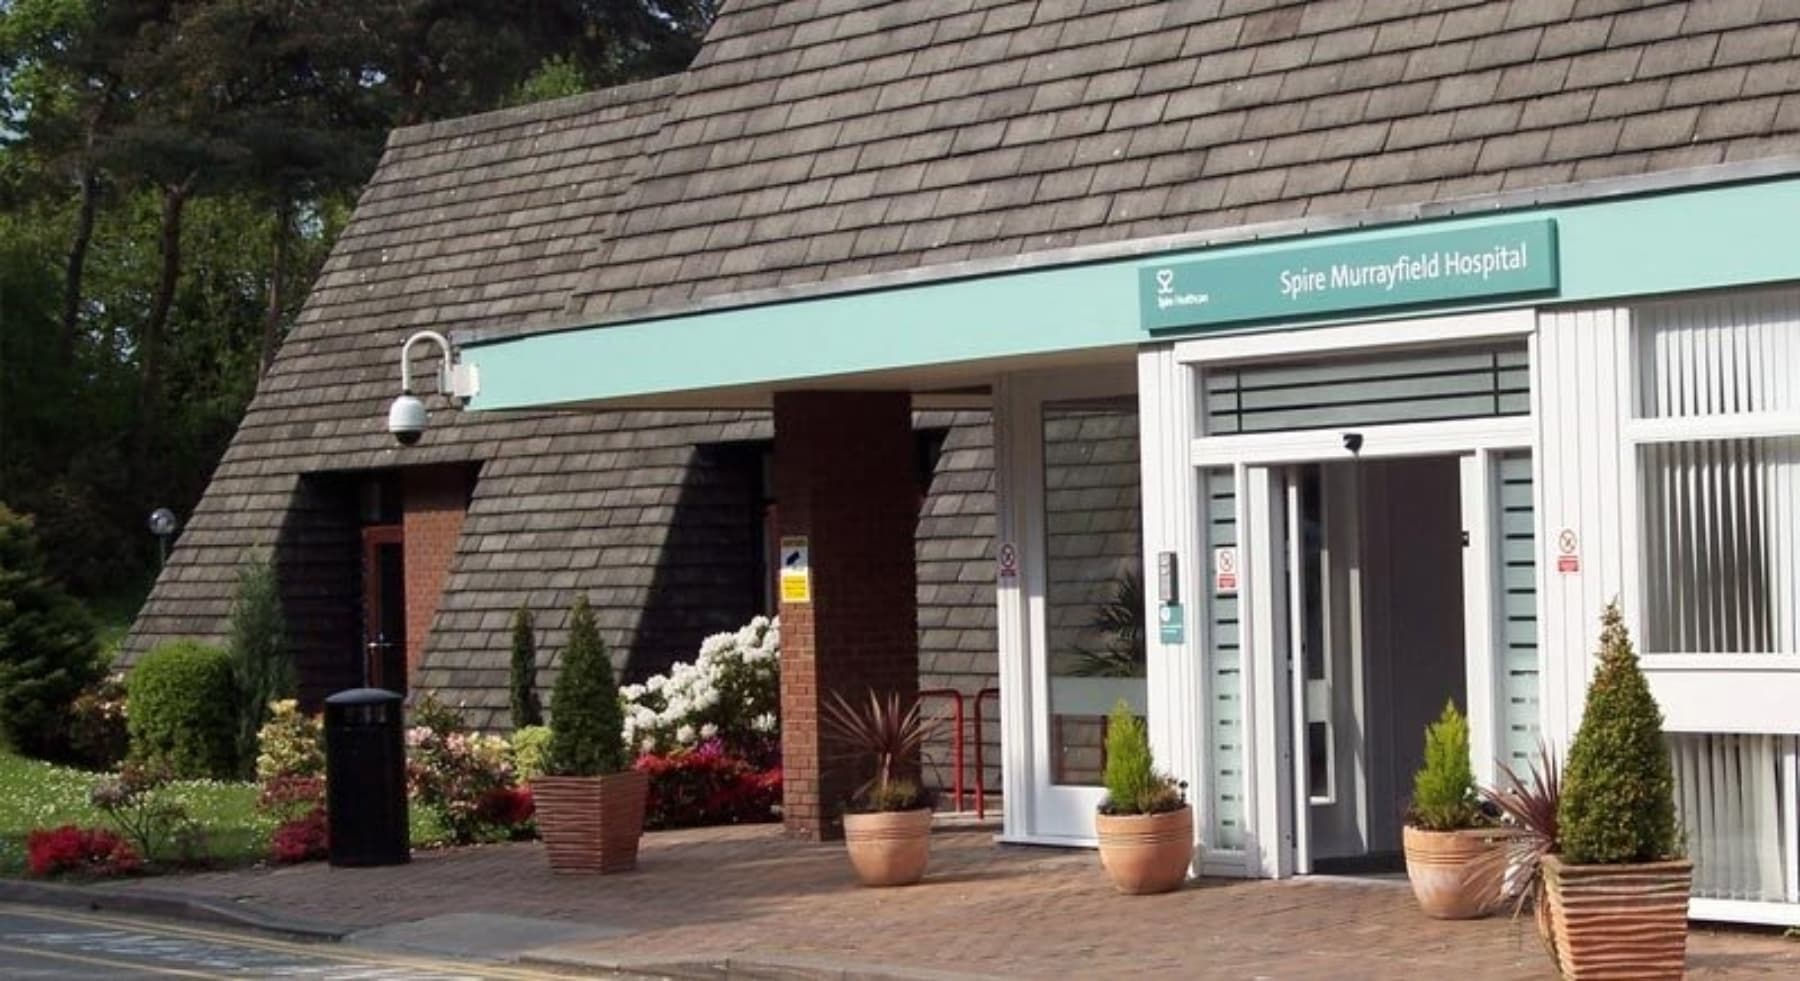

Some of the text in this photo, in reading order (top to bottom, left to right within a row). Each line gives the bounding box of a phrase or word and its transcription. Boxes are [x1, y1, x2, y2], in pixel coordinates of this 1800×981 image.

[1280, 240, 1527, 300] Spire Murrayfield Hospital
